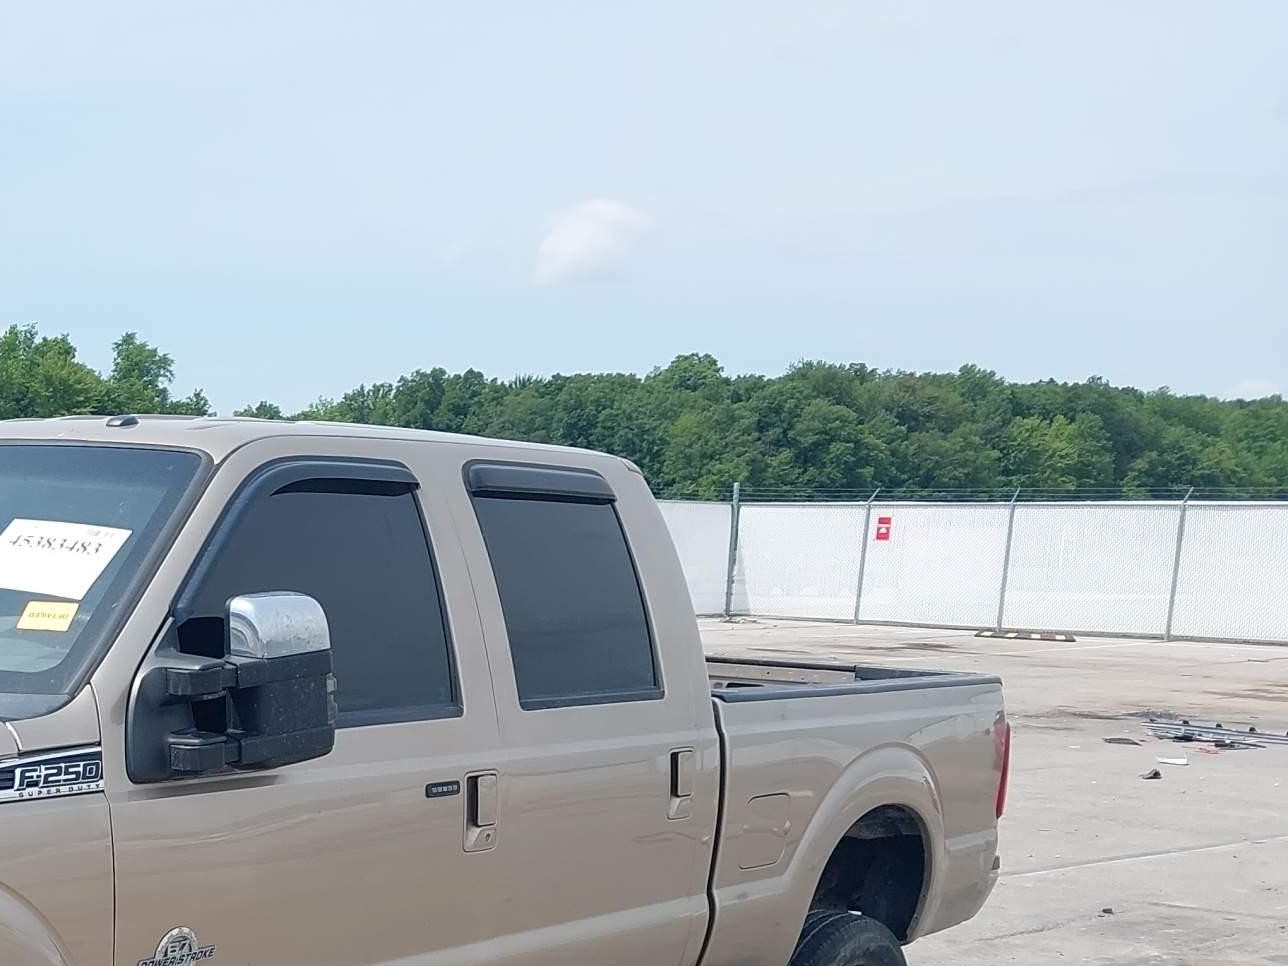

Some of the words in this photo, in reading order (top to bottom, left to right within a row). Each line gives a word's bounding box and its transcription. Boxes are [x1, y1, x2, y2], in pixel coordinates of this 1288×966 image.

[9, 534, 104, 555] 45383483
[14, 760, 102, 791] F-250
[18, 788, 62, 798] SUPER
[67, 783, 101, 793] DUTY
